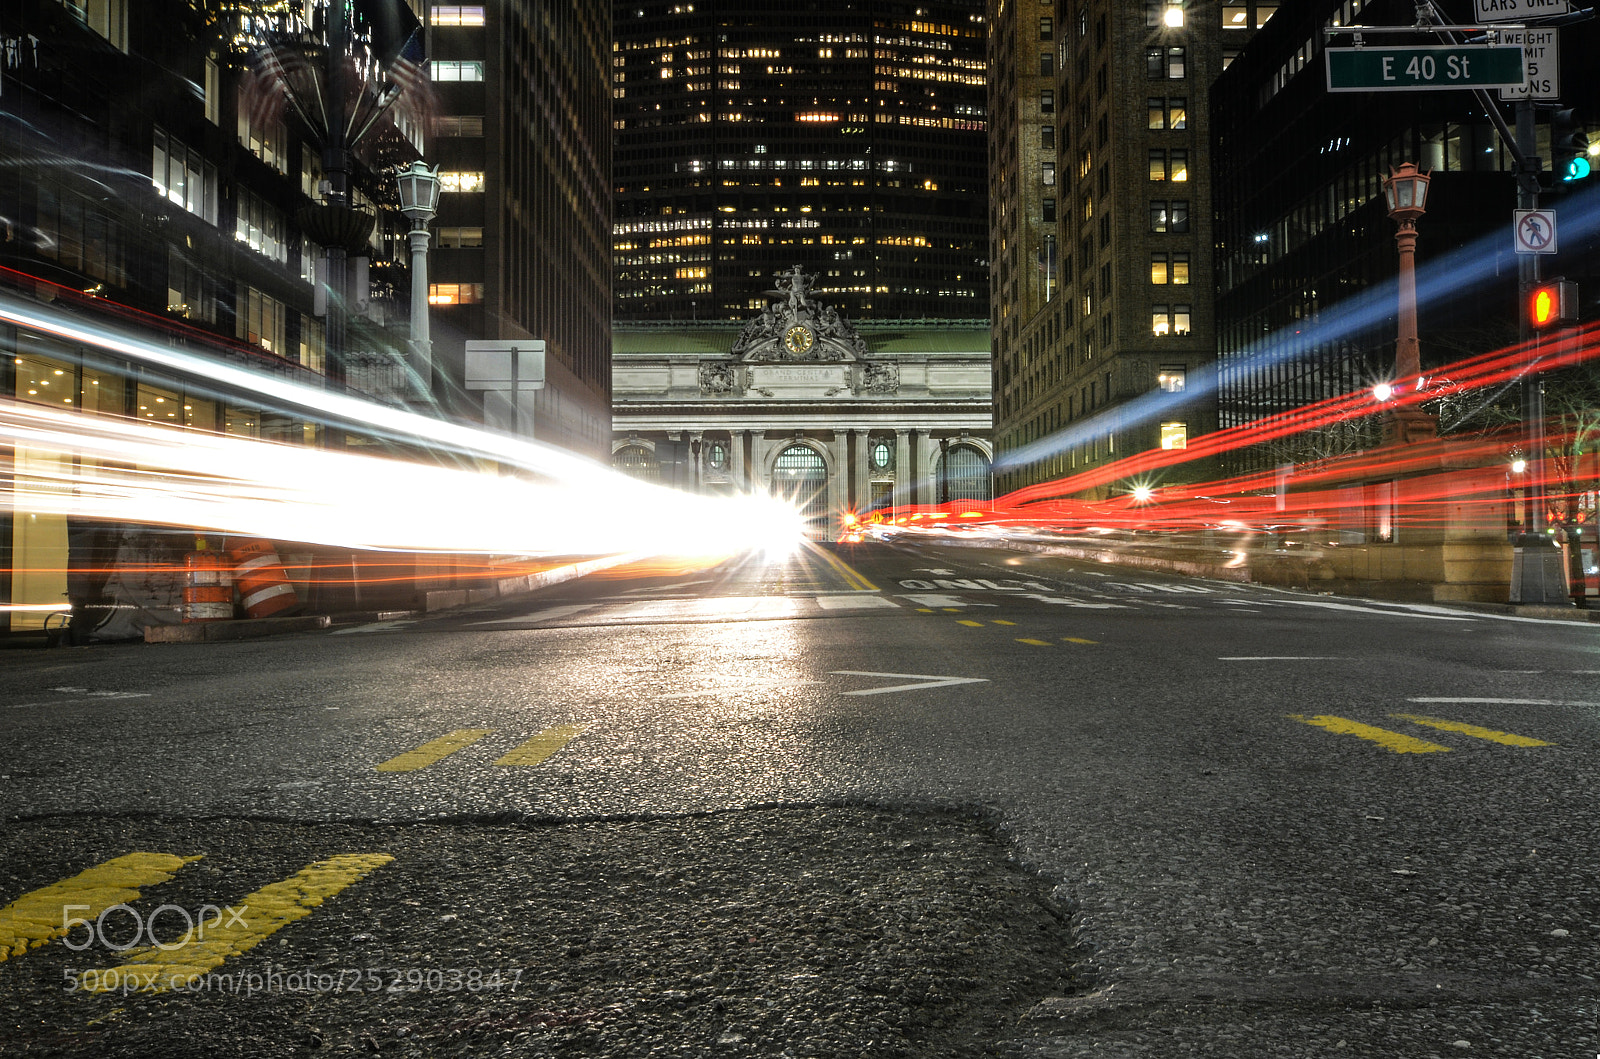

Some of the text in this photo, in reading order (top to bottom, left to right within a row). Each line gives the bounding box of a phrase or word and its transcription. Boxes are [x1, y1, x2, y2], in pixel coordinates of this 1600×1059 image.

[1481, 0, 1517, 12] CARS
[1504, 33, 1553, 45] WEIGHT
[1524, 47, 1546, 59] MIT
[1382, 55, 1471, 81] E 40 St
[1527, 62, 1539, 76] 5
